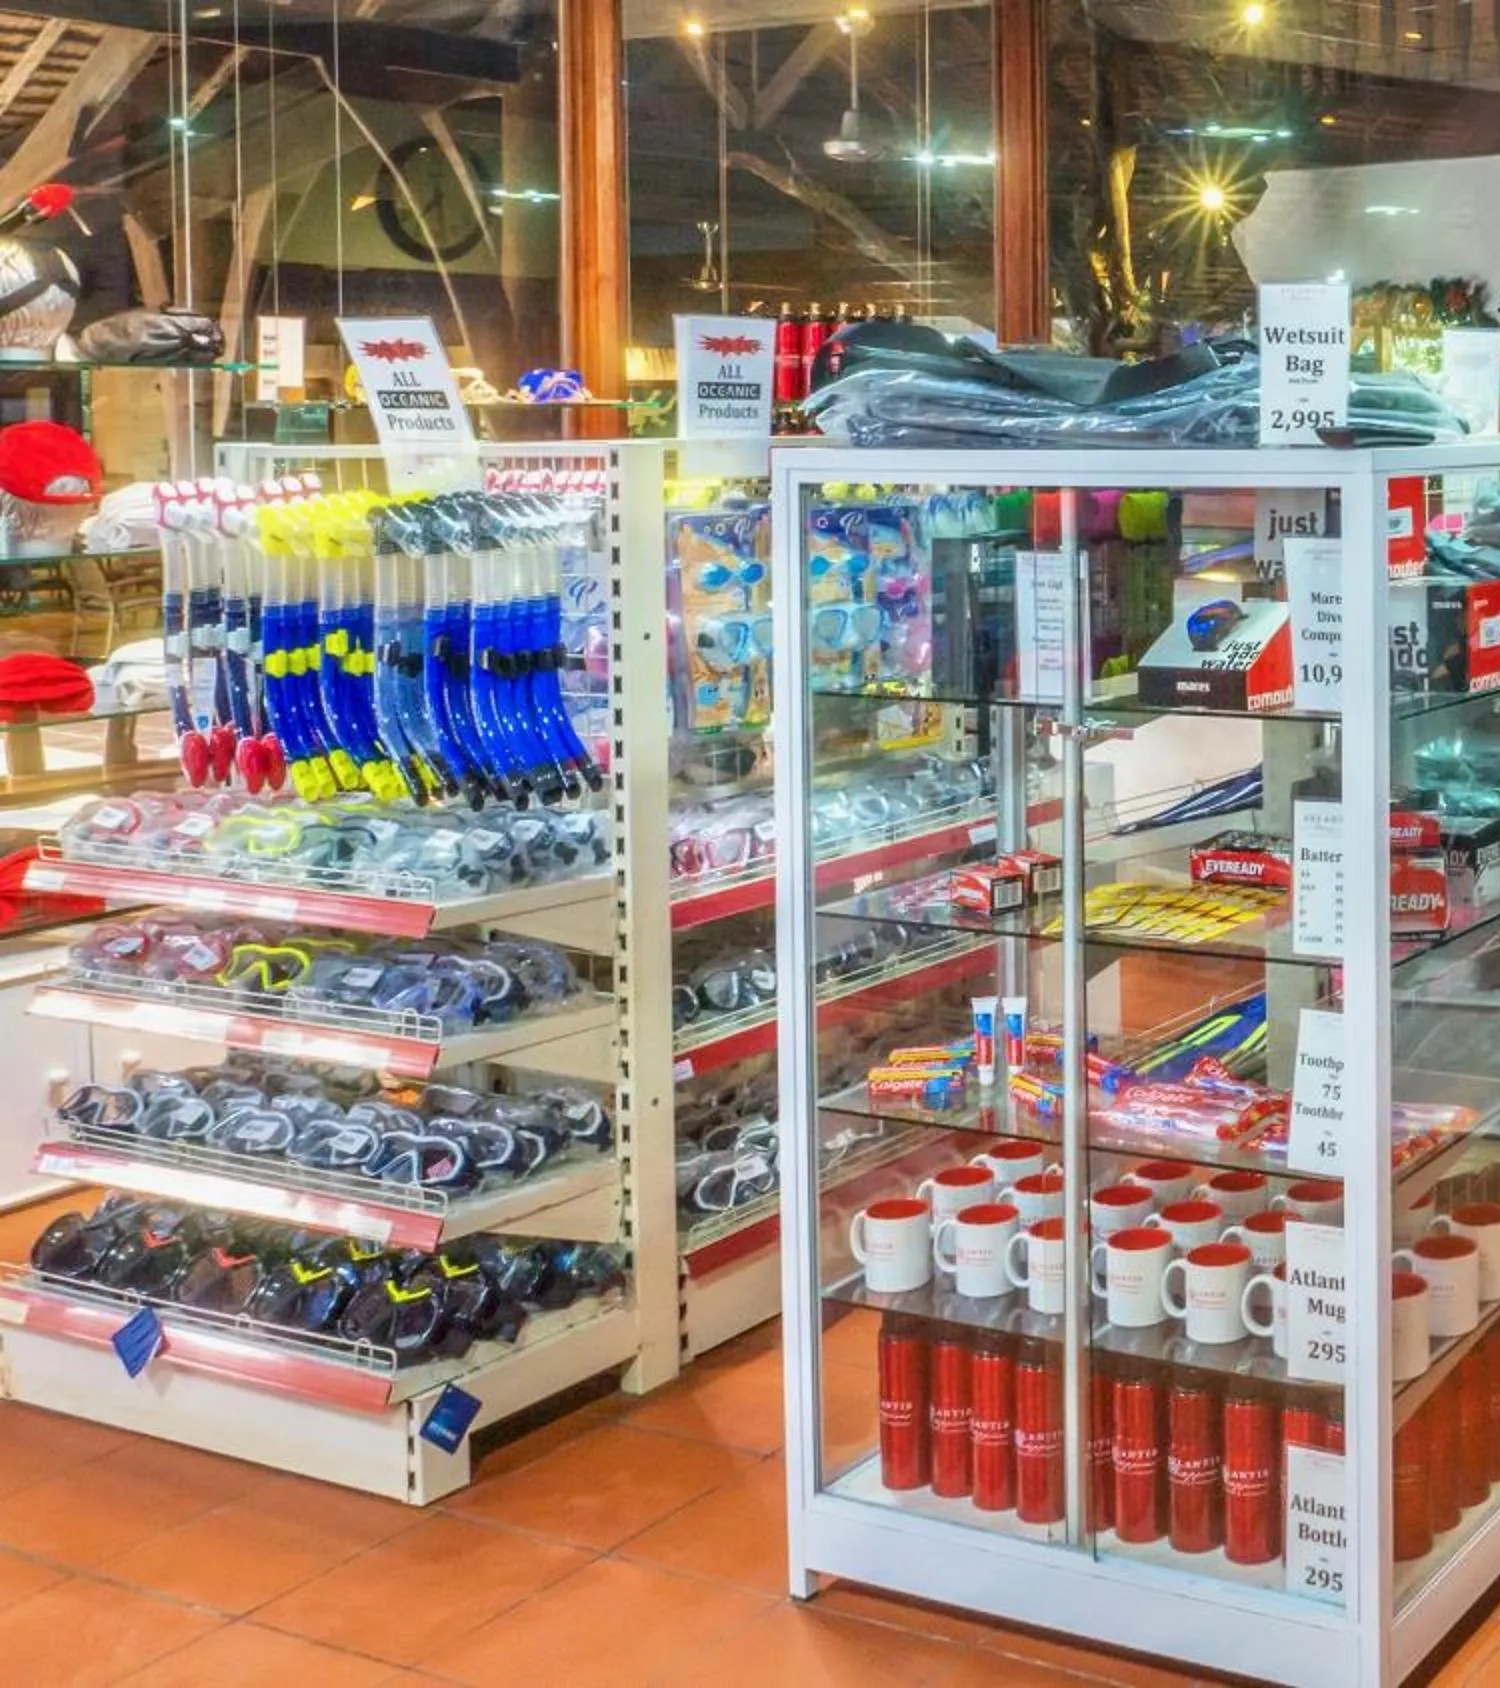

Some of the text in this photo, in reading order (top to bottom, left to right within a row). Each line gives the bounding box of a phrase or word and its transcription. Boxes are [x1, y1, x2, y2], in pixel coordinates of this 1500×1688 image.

[1264, 326, 1345, 344] Wetsuit
[717, 364, 744, 379] ALL
[1285, 355, 1324, 377] Bag
[393, 371, 421, 387] ALL
[380, 391, 448, 408] OCEANIC
[699, 383, 760, 398] OCEANIC
[699, 403, 759, 419] Products
[387, 413, 456, 431] Products
[1271, 409, 1336, 432] 2,995
[1268, 509, 1318, 540] just
[1311, 592, 1343, 605] Mare
[1317, 611, 1343, 623] Div
[1301, 629, 1343, 644] Comp
[1300, 664, 1343, 686] 10,9
[1248, 683, 1294, 711] comput
[1300, 847, 1343, 863] Batter
[1204, 858, 1264, 876] EVEREADY
[1390, 892, 1441, 912] READY
[1300, 1053, 1344, 1073] Toothp
[1322, 1083, 1342, 1101] 75
[1295, 1102, 1344, 1121] Toothbr
[1317, 1141, 1338, 1157] 45
[1289, 1268, 1345, 1291] Atlant
[1307, 1297, 1346, 1323] Mug
[1307, 1341, 1346, 1364] 295
[1291, 1494, 1346, 1521] Atlant
[1298, 1522, 1347, 1548] Bottl
[1304, 1565, 1344, 1592] 295
